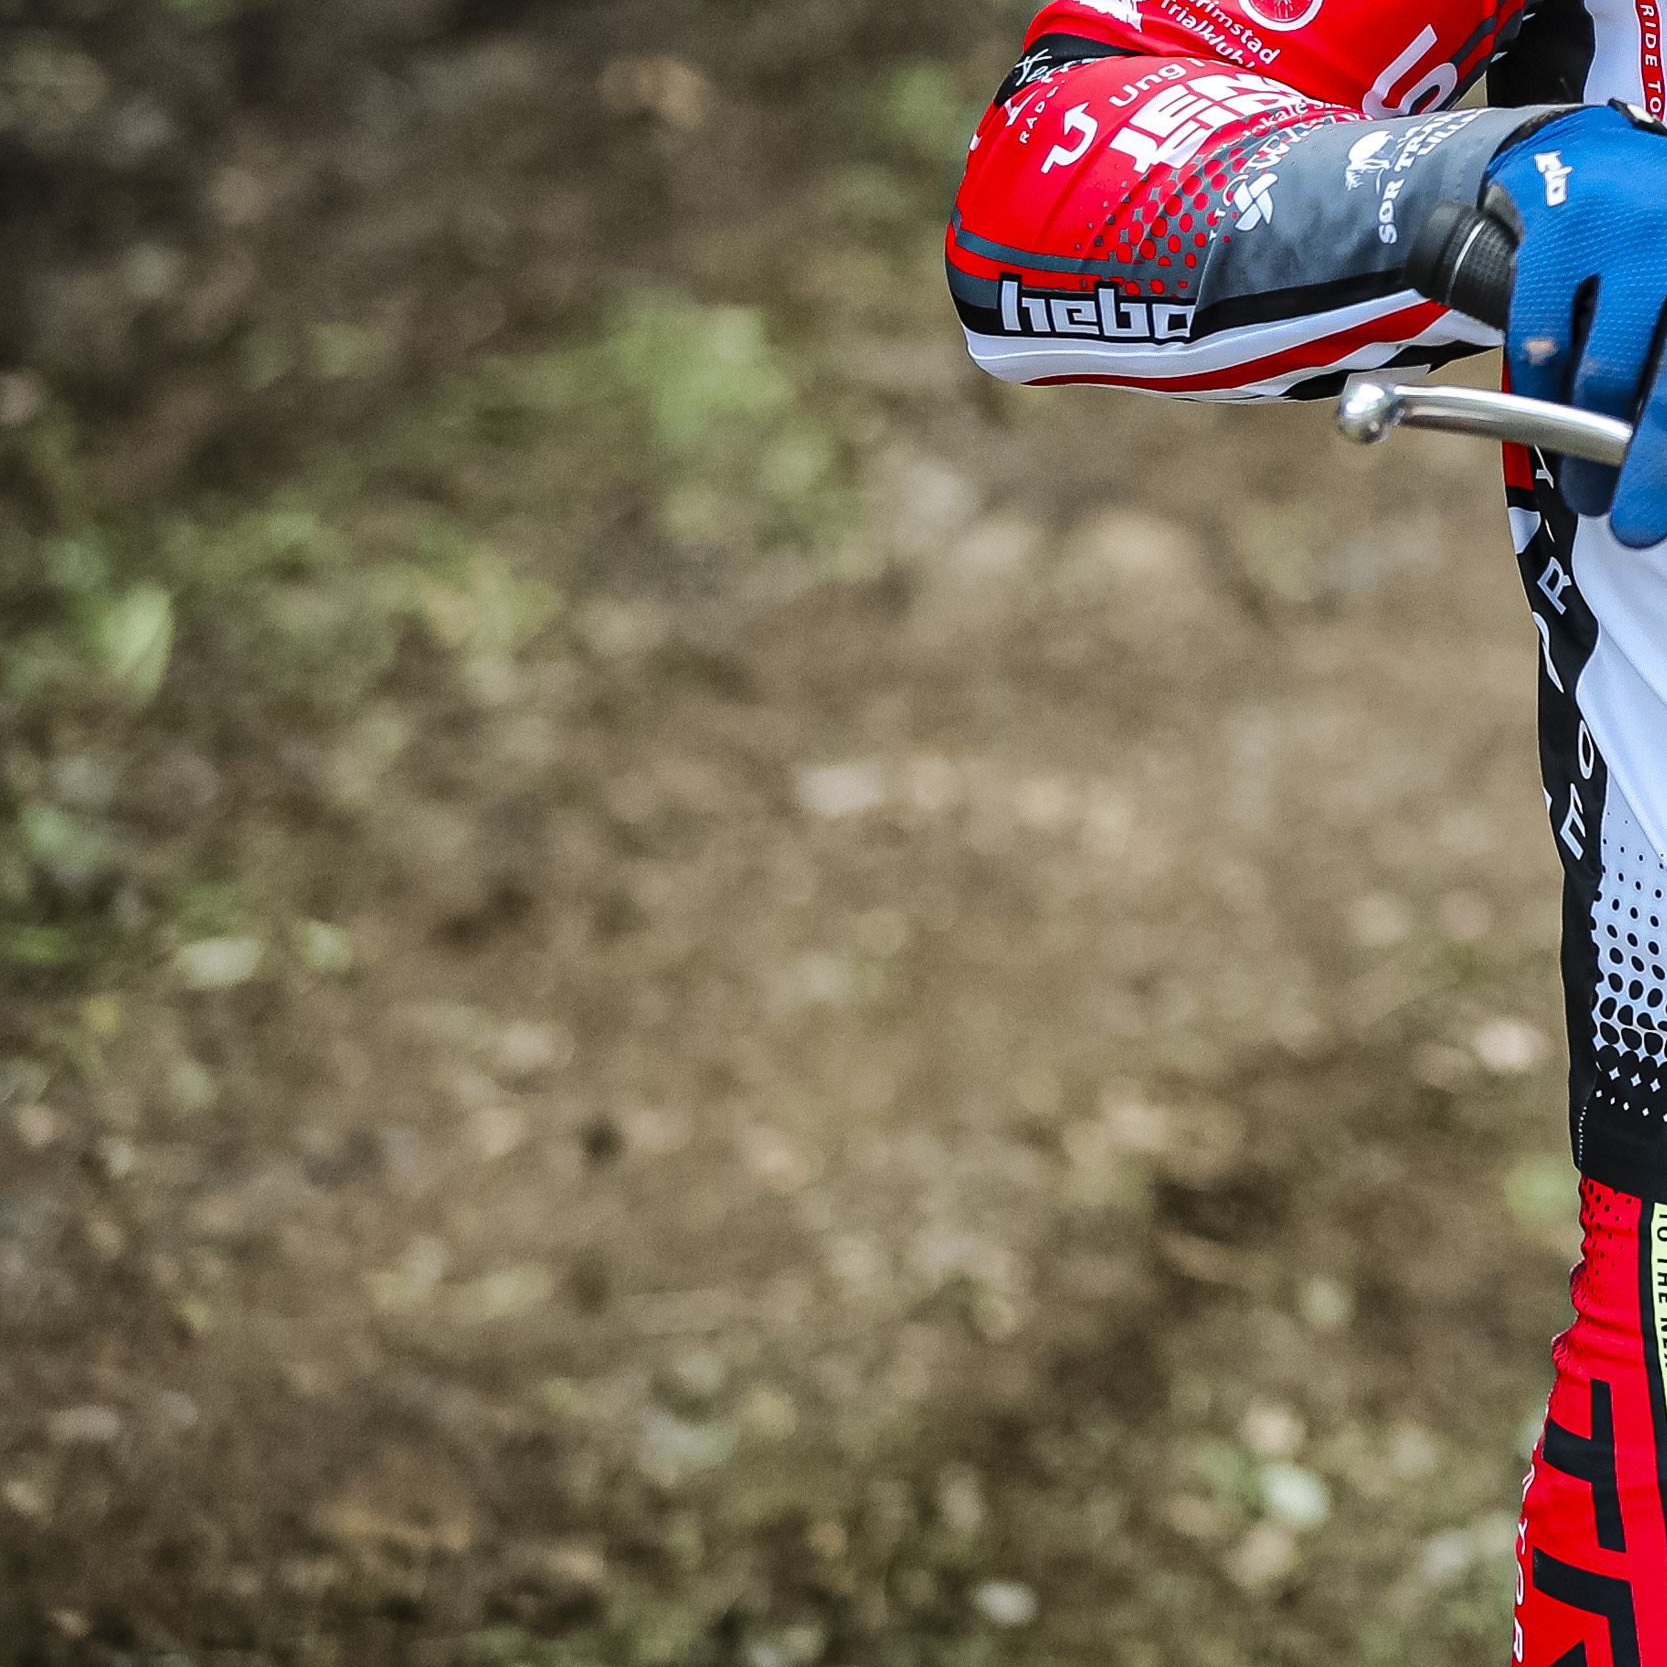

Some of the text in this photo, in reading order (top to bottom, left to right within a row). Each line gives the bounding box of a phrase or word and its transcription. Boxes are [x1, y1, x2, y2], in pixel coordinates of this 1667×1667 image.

[1108, 61, 1188, 107] Ung
[1640, 3, 1662, 114] RIDE TO
